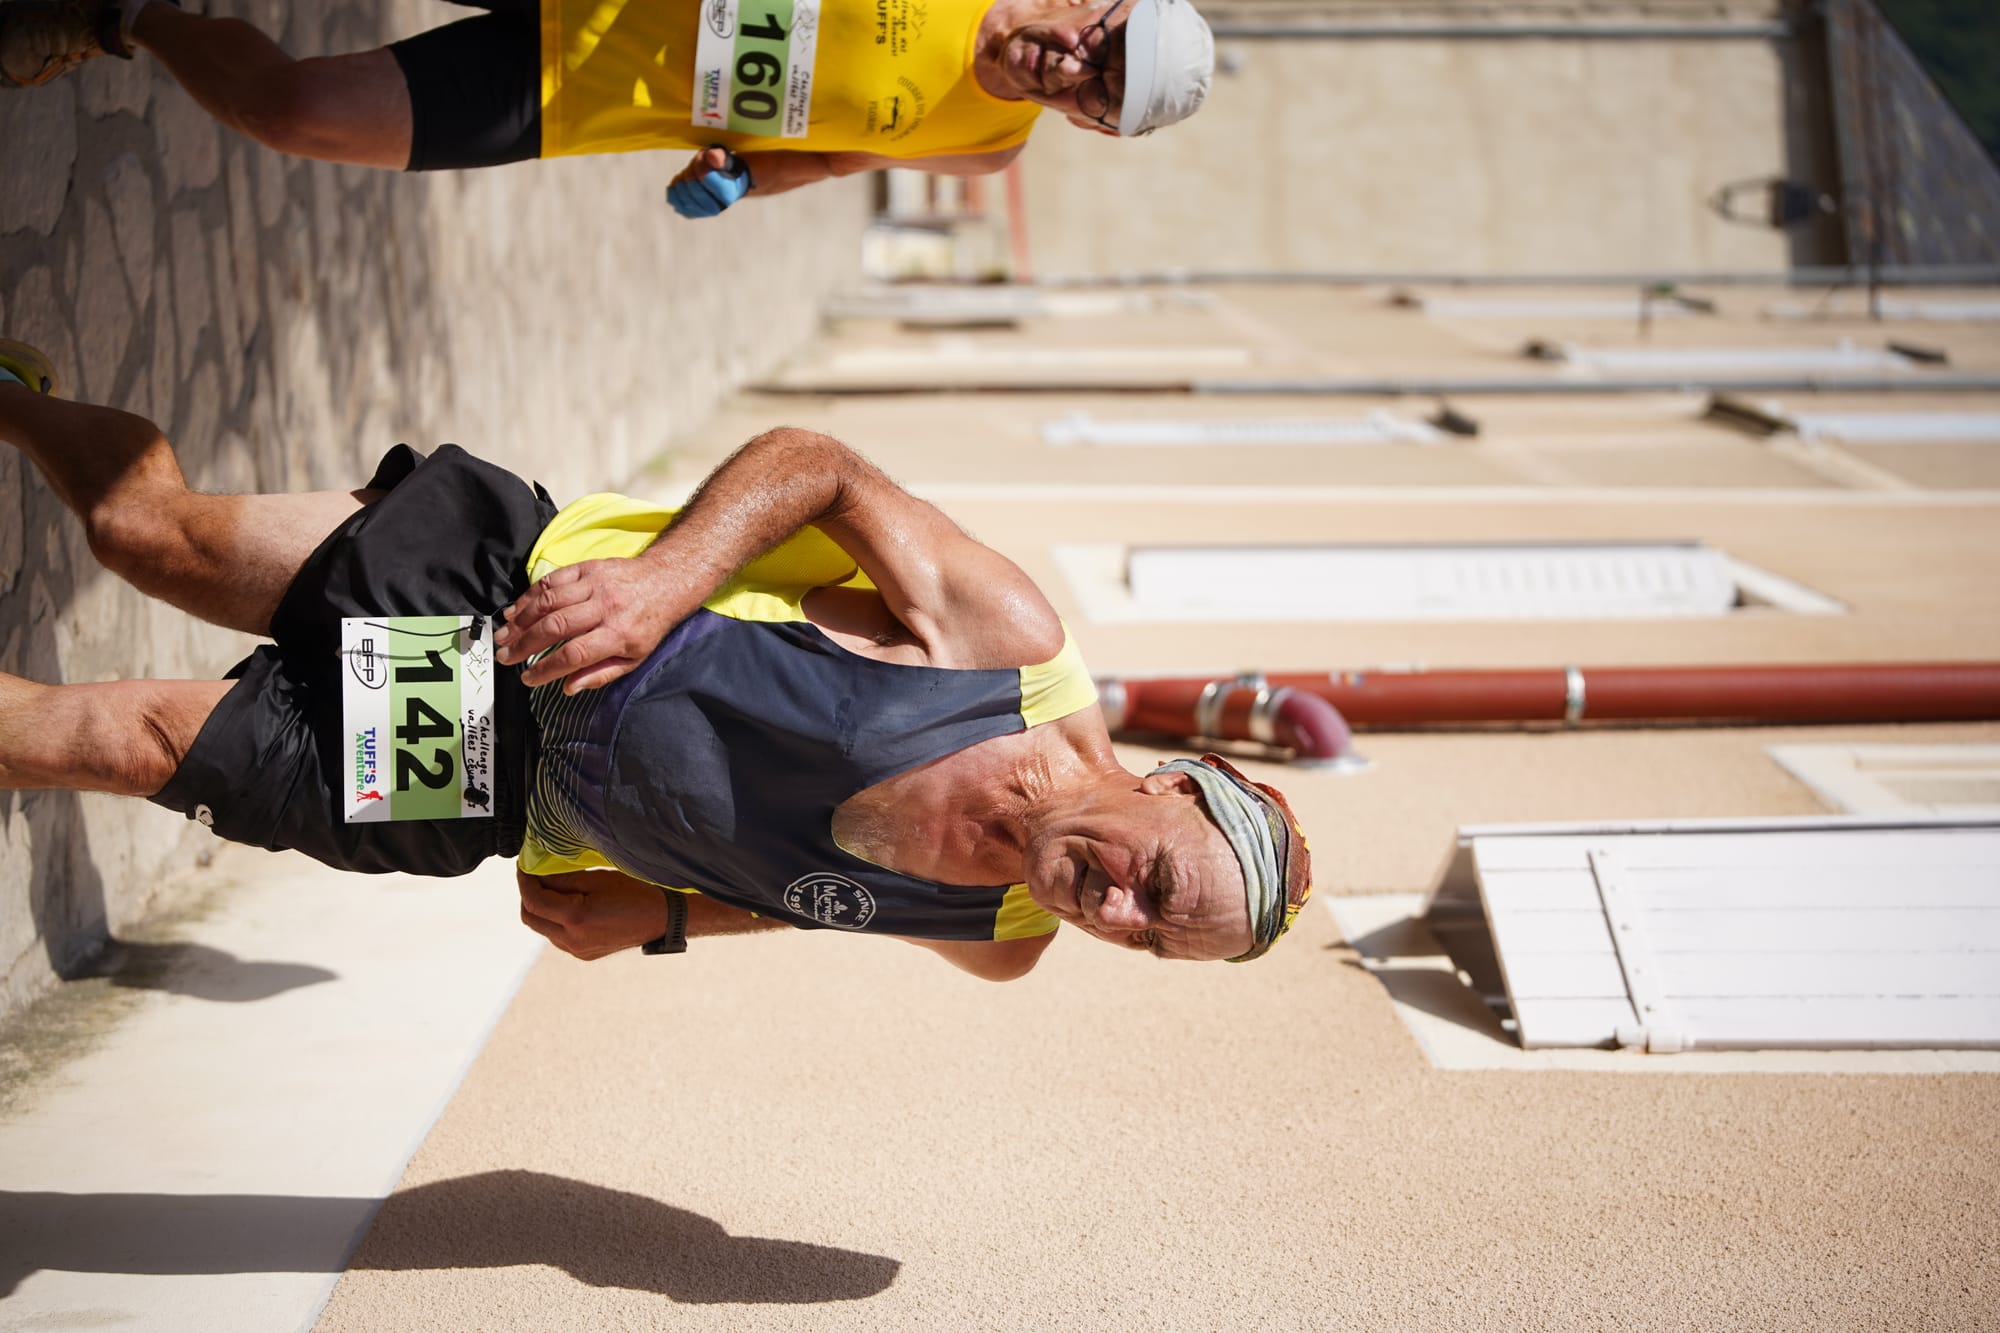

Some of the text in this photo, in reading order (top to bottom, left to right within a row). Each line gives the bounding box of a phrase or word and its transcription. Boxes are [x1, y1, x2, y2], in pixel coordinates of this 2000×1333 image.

[709, 67, 720, 108] TUFF'S
[733, 13, 785, 120] 160
[362, 638, 374, 682] BFP
[395, 650, 453, 791] 142
[467, 709, 479, 751] vallées
[476, 715, 490, 775] Challenge
[356, 733, 367, 790] Aventure
[364, 727, 376, 784] TUFF'S
[853, 889, 870, 922] SINCE
